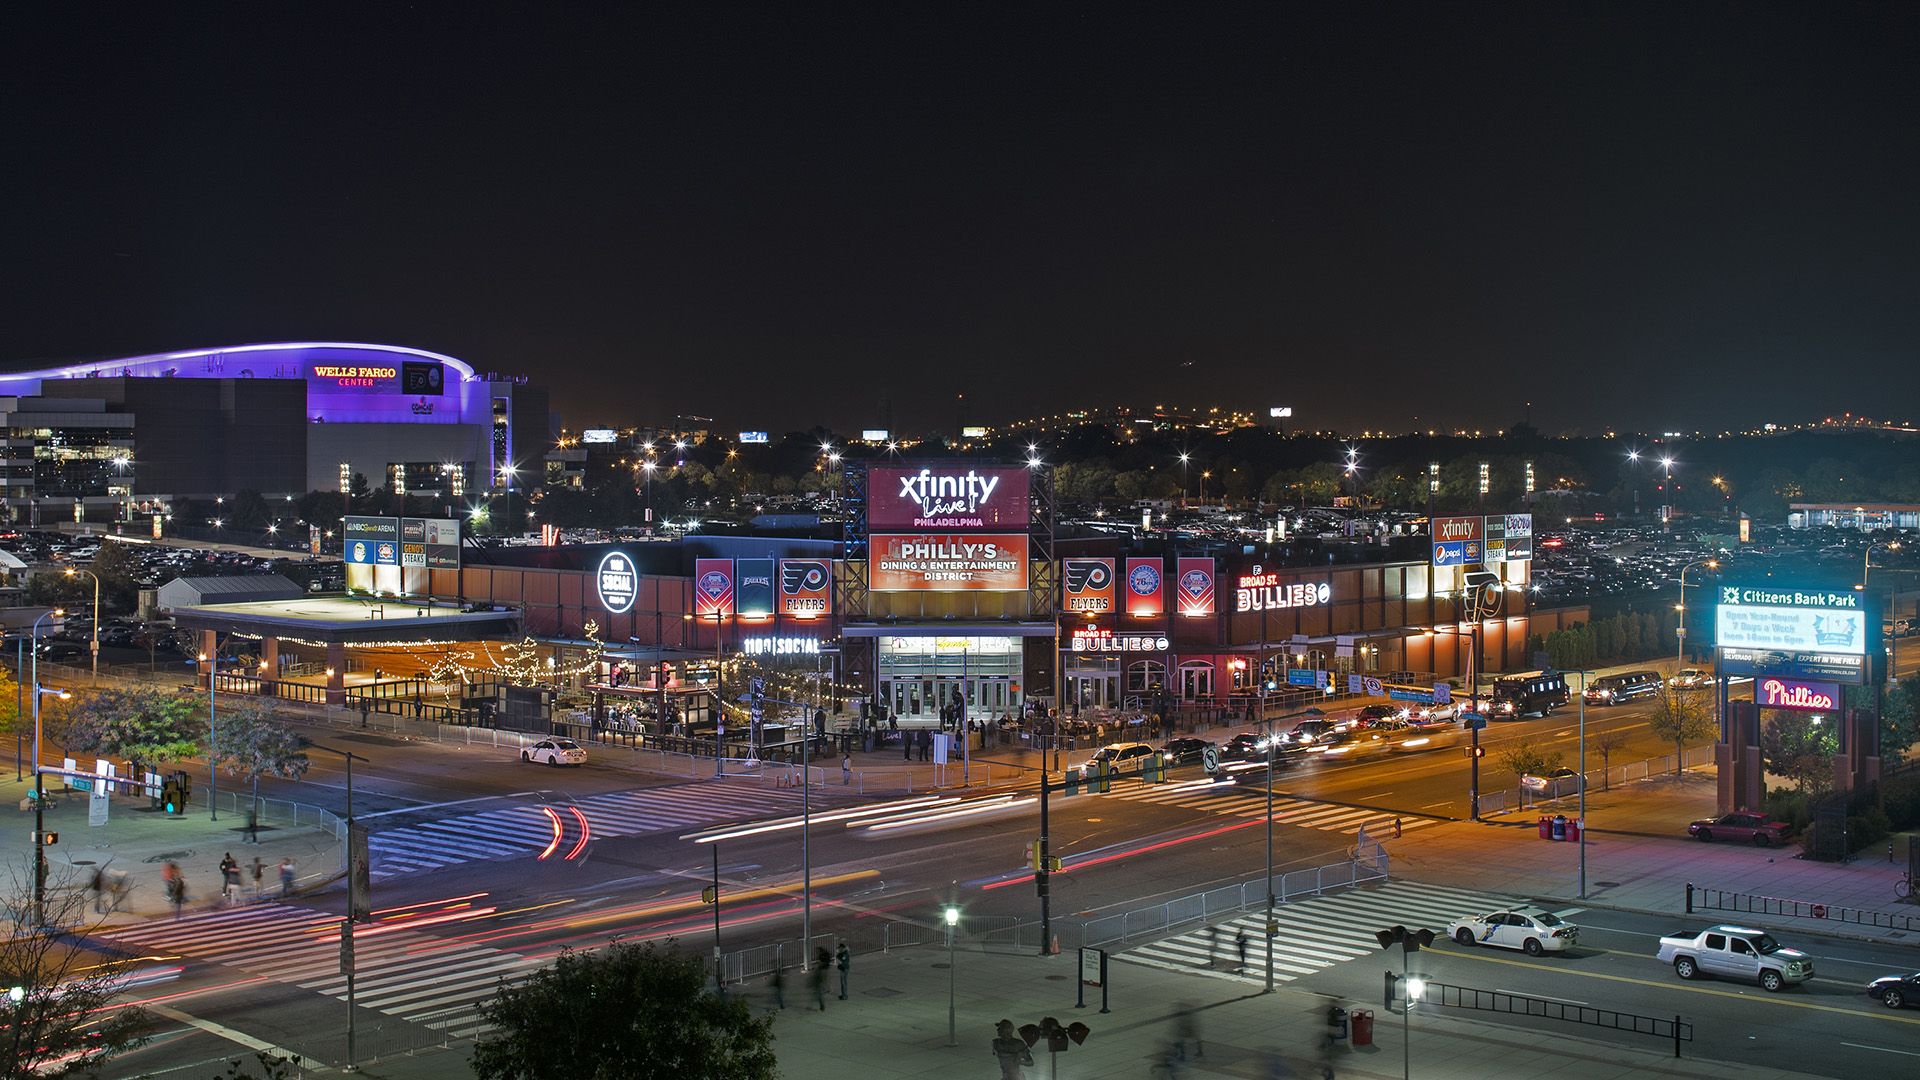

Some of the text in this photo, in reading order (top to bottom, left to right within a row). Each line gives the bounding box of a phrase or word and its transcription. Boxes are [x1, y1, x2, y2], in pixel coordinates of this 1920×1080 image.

[314, 366, 396, 378] WELLS FARGO
[338, 378, 374, 386] CENTER
[899, 469, 1000, 504] xfinity
[922, 494, 976, 518] Live!
[914, 518, 984, 527] PHILADELPHIA
[1442, 520, 1474, 540] xfinity
[902, 544, 997, 560] PHILLY'S
[1445, 549, 1460, 559] pepsi
[1487, 550, 1504, 559] STEAKS
[404, 554, 424, 563] STEAKS
[881, 562, 918, 570] DINING
[930, 562, 1017, 570] ENTERTAINMENT
[743, 577, 769, 587] EAGLES
[924, 572, 974, 581] DISTRICT
[1240, 574, 1278, 588] BROAD ST.
[1237, 583, 1318, 612] BULLIES
[1743, 590, 1856, 607] Citizens Bank Park
[786, 598, 826, 610] FLYERS
[1070, 598, 1109, 610] FLYERS
[777, 638, 820, 654] SOCIAL
[1072, 637, 1155, 652] BULLIES
[1798, 655, 1822, 663] EXPERT
[1764, 680, 1832, 708] Phillies
